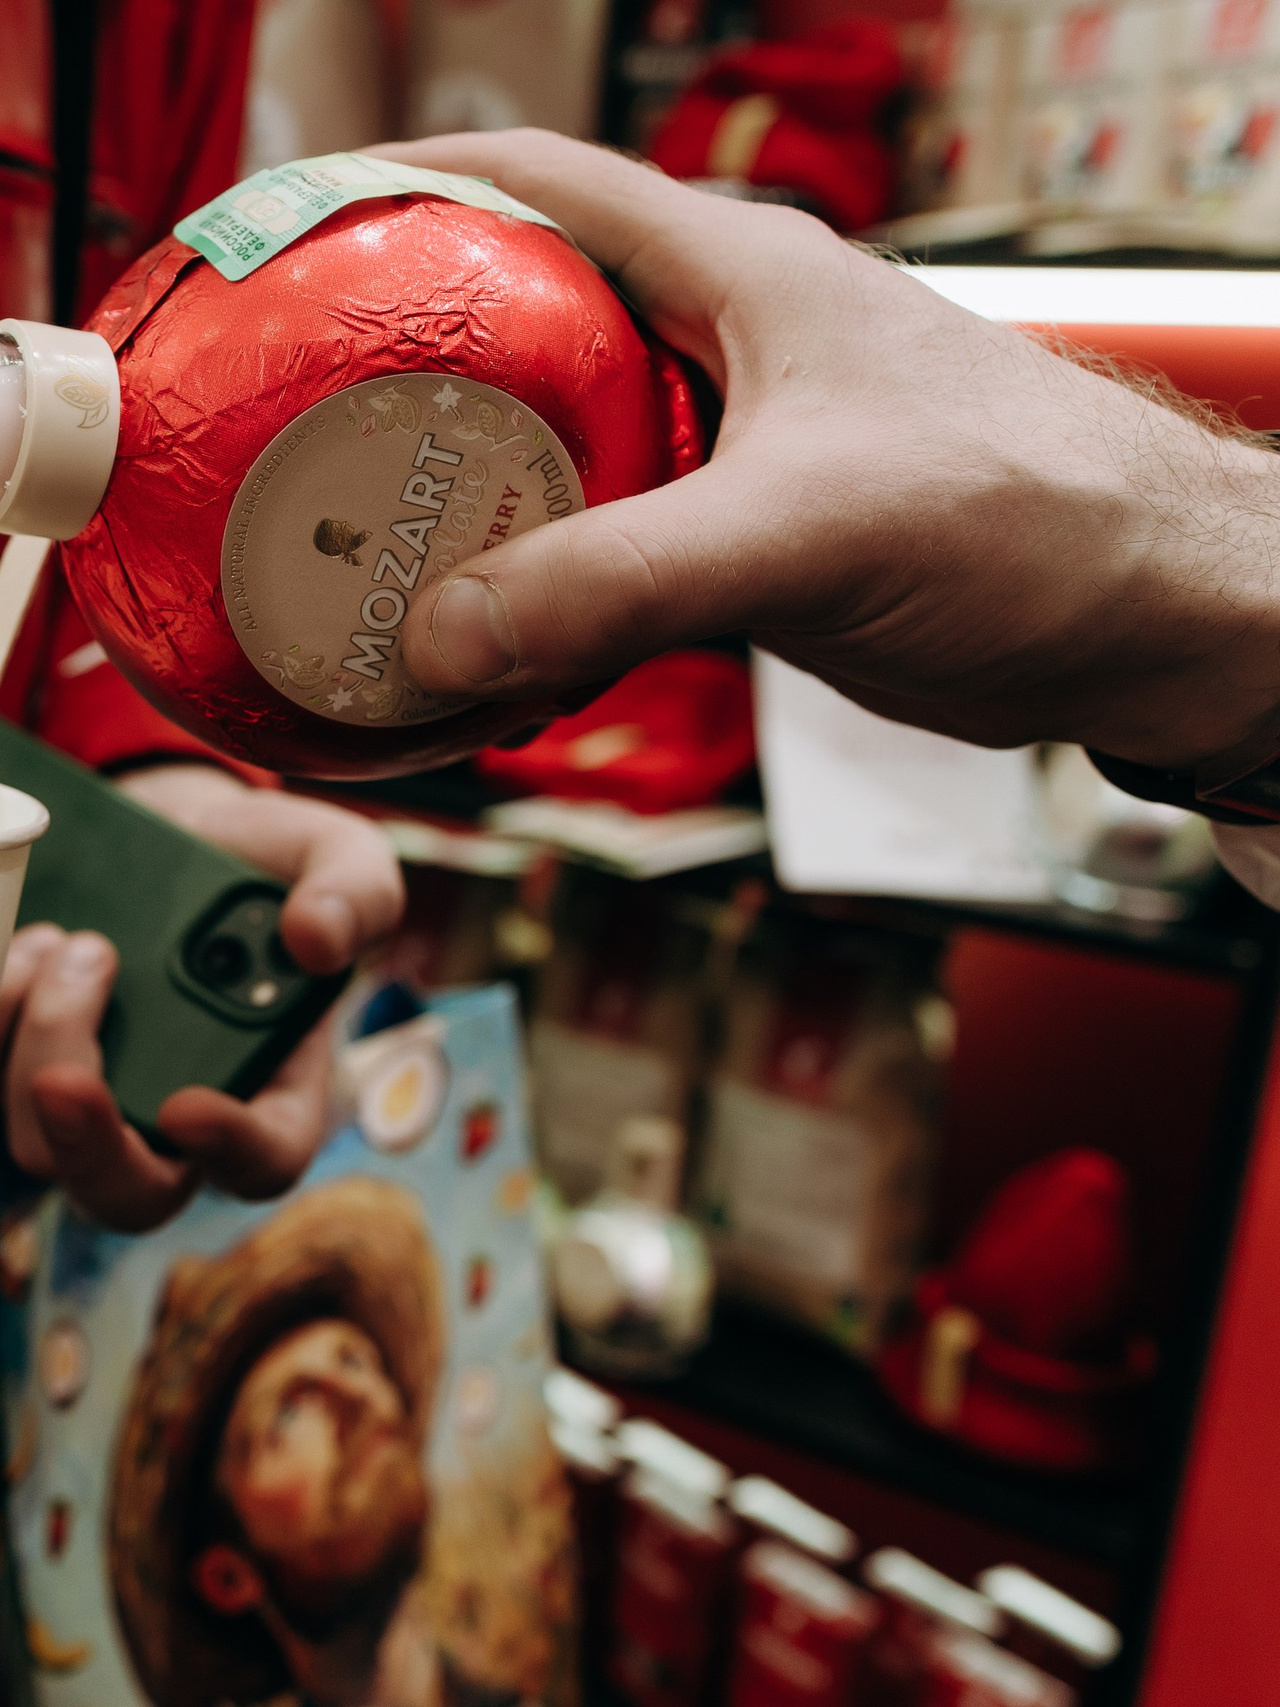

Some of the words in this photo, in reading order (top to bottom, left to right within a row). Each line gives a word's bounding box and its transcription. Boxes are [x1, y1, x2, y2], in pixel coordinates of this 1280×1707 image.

[243, 414, 327, 517] INGREDIENTS
[231, 519, 250, 602] NATURAL
[340, 431, 464, 681] MOZART
[237, 604, 258, 633] ALL
